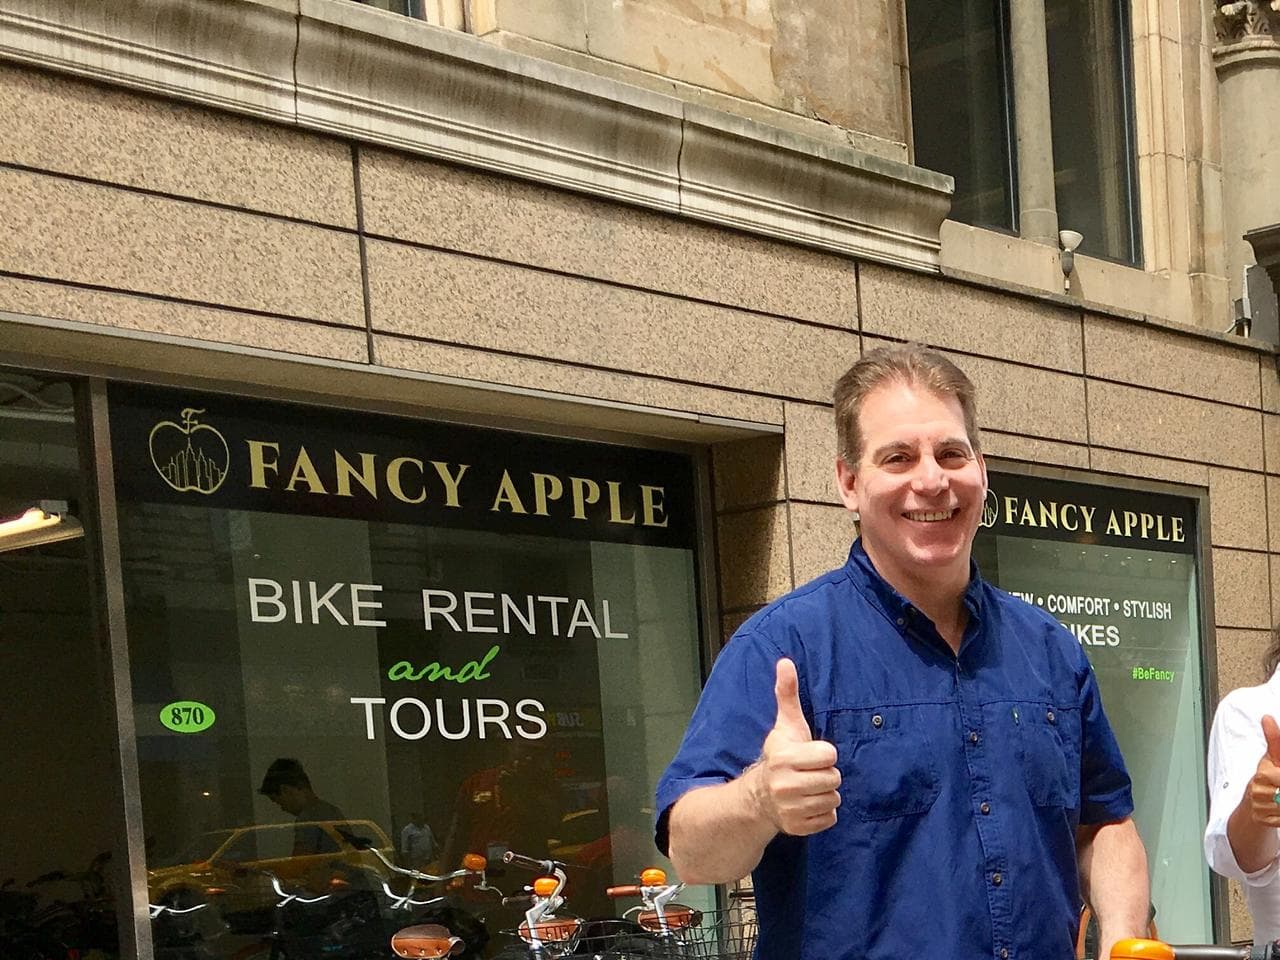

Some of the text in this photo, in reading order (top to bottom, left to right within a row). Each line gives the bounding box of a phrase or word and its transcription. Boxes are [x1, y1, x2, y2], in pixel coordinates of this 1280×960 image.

[244, 438, 670, 529] FANCY APPLE
[1003, 496, 1186, 543] FANCY APPLE
[248, 577, 629, 640] BIKE RENTAL
[1047, 593, 1111, 617] COMFORT
[1123, 600, 1172, 620] STYLISH
[1060, 623, 1120, 647] IKES
[388, 645, 501, 684] and
[1132, 667, 1175, 683] #BeFancy
[171, 706, 205, 726] 870
[350, 696, 549, 741] TOURS
